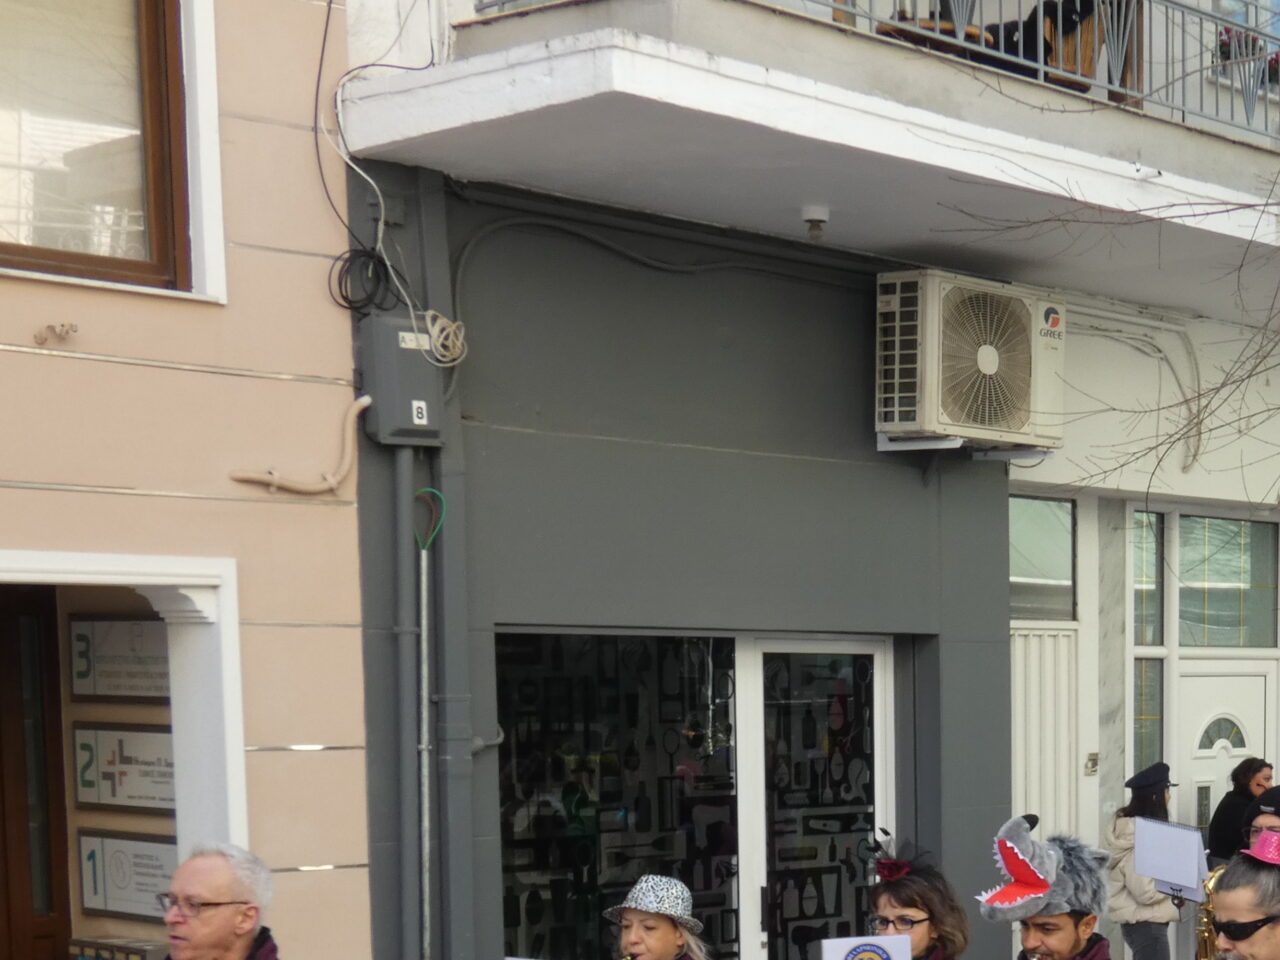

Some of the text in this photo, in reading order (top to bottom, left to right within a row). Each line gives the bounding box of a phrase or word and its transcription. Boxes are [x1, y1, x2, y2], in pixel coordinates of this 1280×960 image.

[1039, 328, 1063, 340] GREE
[416, 406, 425, 420] 8
[75, 633, 91, 680] 3
[80, 743, 95, 788] 2
[87, 849, 98, 896] 1
